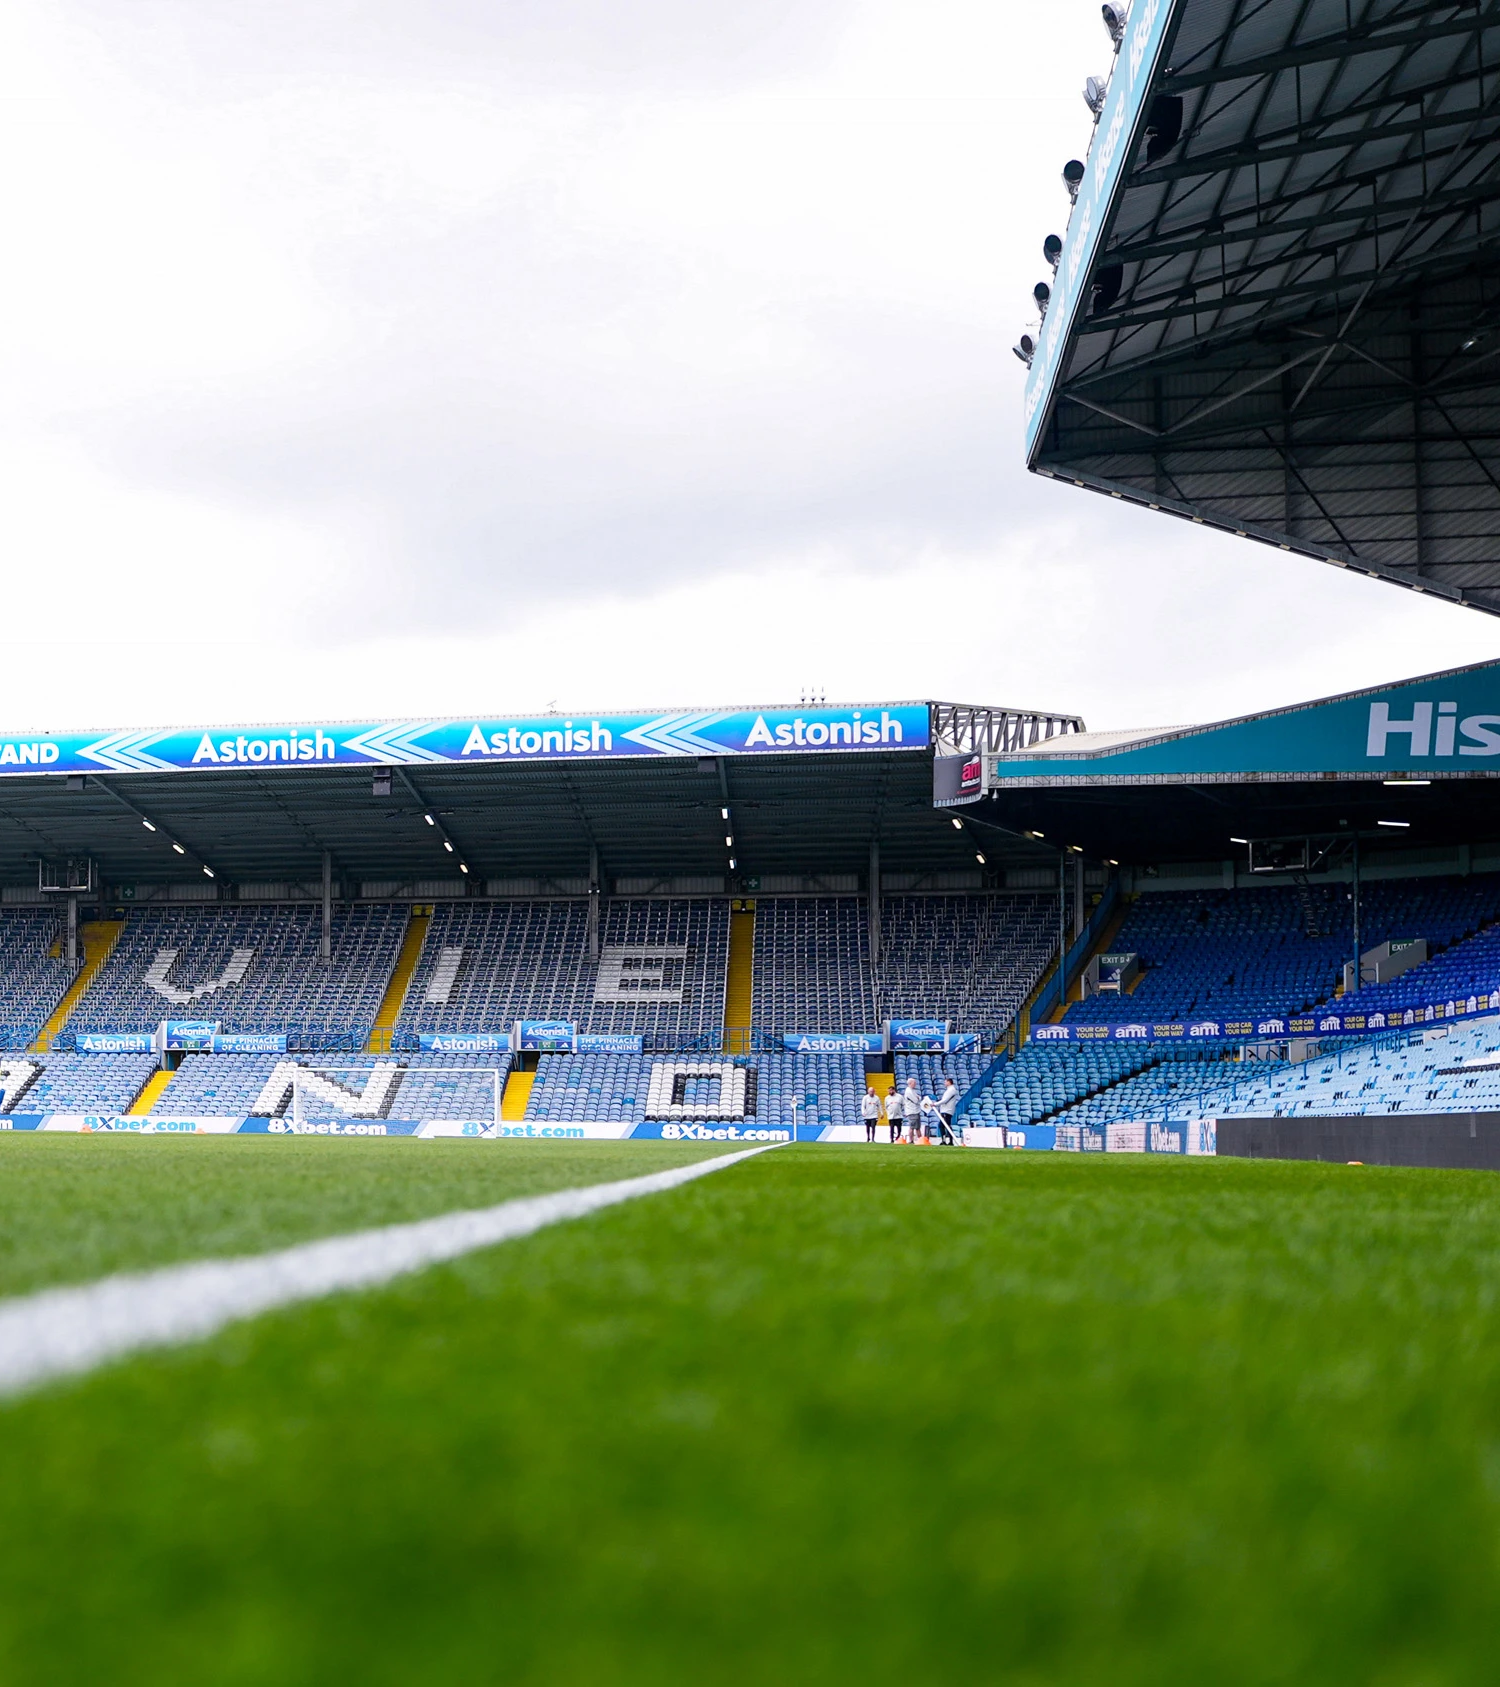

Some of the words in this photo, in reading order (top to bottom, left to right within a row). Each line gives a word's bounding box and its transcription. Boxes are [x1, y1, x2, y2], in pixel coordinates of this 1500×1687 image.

[745, 712, 903, 748] Astonish
[461, 720, 612, 757] Astonish
[191, 728, 335, 764] Astonish
[1101, 956, 1119, 964] EXIT
[1258, 1021, 1284, 1034] amt
[1320, 1017, 1340, 1030] amt
[1368, 1014, 1385, 1028] amt
[172, 1026, 211, 1036] Astonish
[526, 1026, 568, 1036] Astonish
[896, 1026, 940, 1035] Astonish
[1036, 1027, 1069, 1039] amt
[1115, 1026, 1147, 1038] amt
[1190, 1024, 1220, 1036] amt
[82, 1036, 146, 1051] Astonish
[431, 1035, 498, 1051] Astonish
[799, 1036, 869, 1051] Astonish
[83, 1116, 196, 1131] 8Xbet.com
[268, 1118, 387, 1135] 8Xbet.com
[461, 1122, 585, 1138] 8Xbet.com
[660, 1123, 790, 1141] 8Xbet.com
